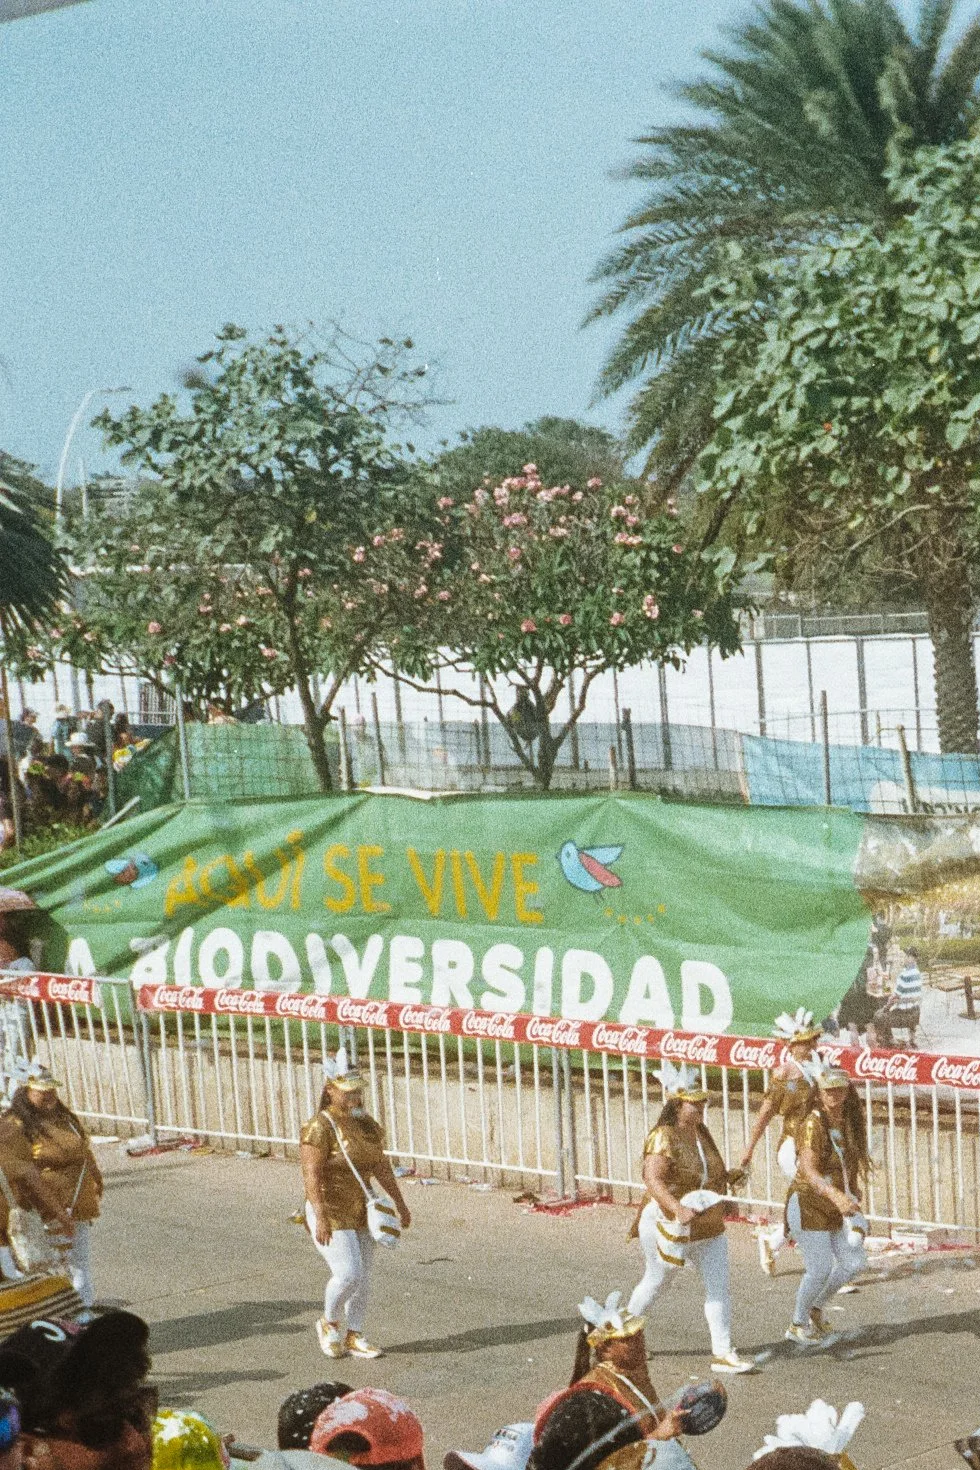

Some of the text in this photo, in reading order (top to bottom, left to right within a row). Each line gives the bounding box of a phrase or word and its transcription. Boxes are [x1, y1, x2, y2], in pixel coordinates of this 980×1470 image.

[165, 829, 545, 924] AQUÍ SE VIVE
[129, 925, 734, 1034] BIODIVERSIDAD
[152, 985, 204, 1010] Coca-Cola
[214, 988, 266, 1014] Coca-Cola
[276, 992, 326, 1020] Coca-Cola
[336, 998, 388, 1026] Coca-Cola
[399, 1003, 451, 1031] Coca-Cola
[462, 1010, 516, 1039] Coca-Cola
[526, 1016, 581, 1046] Coca-Cola
[592, 1023, 649, 1054] Coca-Cola
[660, 1031, 719, 1063] Coca-Cola
[855, 1050, 918, 1081] Coca-Cola
